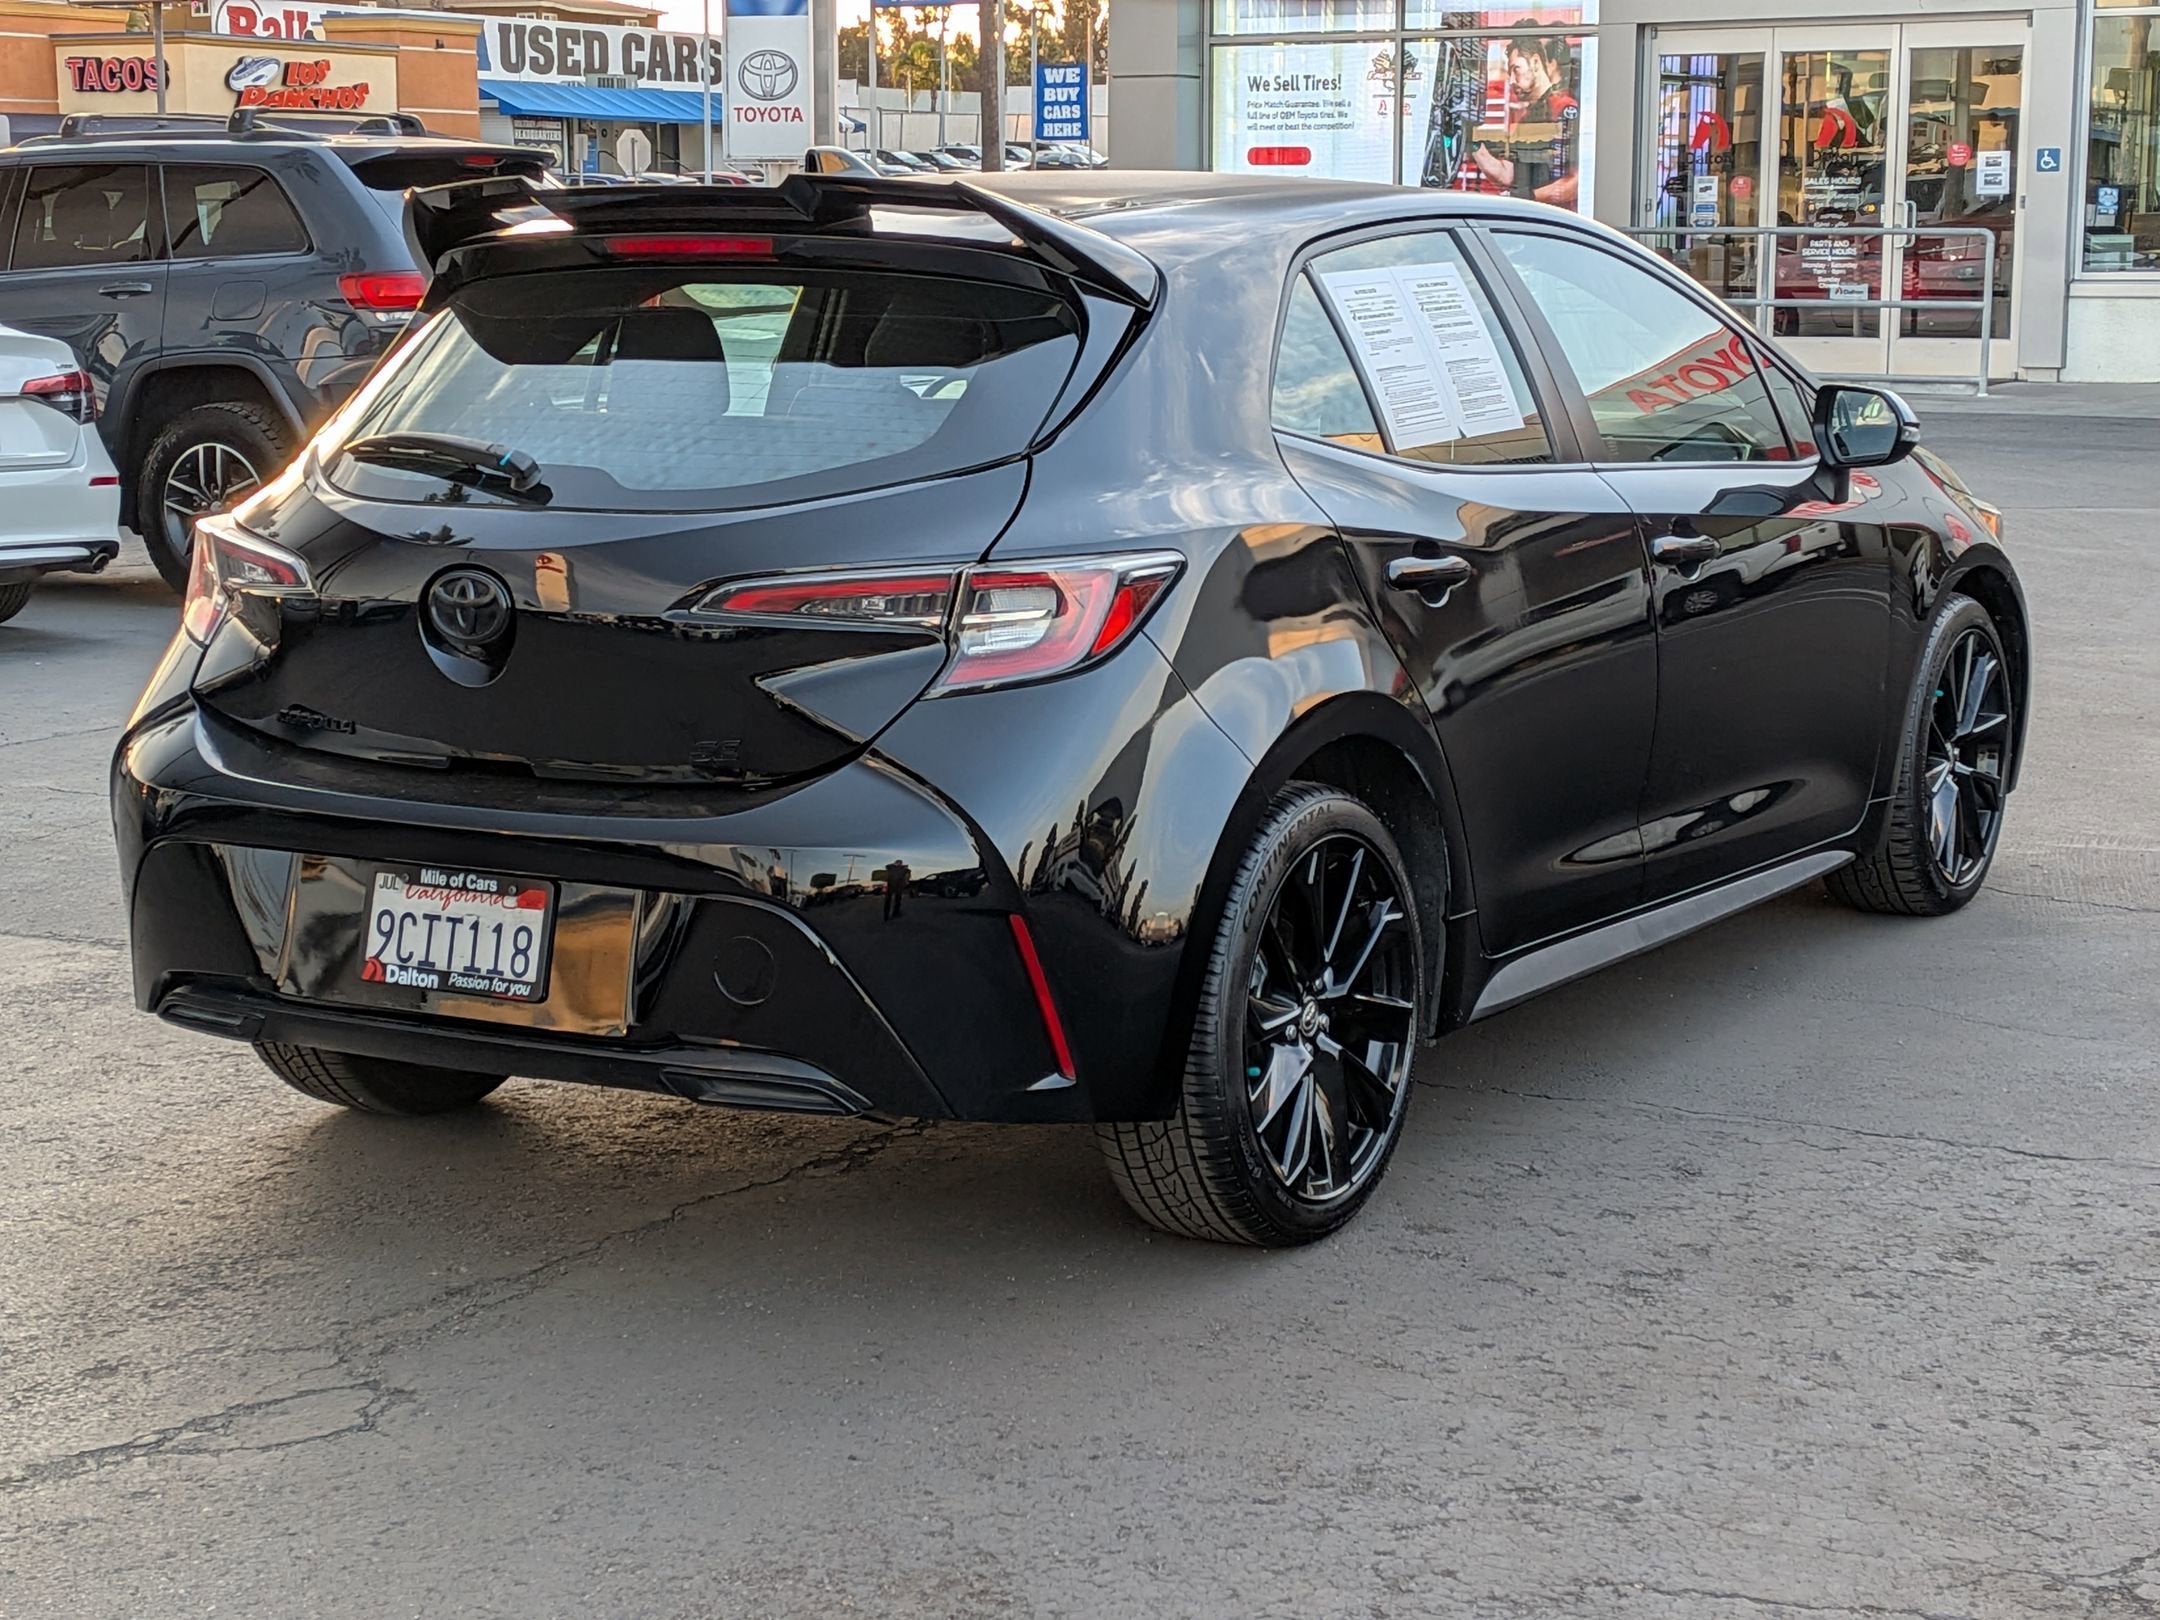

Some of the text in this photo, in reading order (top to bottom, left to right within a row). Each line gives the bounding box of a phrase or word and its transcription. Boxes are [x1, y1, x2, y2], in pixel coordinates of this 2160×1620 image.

[498, 22, 609, 77] USED
[621, 32, 722, 86] CARS
[64, 56, 170, 92] TACOS
[283, 58, 331, 87] LOS
[1044, 68, 1080, 84] WE
[1247, 73, 1342, 92] We Sell Tires!
[1044, 87, 1080, 102] BUY
[733, 107, 804, 123] TOYOTA
[1043, 105, 1081, 119] CARS
[1043, 122, 1082, 137] HERE
[1804, 176, 1862, 186] SALES HOURS
[1802, 246, 1857, 257] SERVICE HOURS
[1809, 239, 1850, 248] PARTS AND
[1243, 803, 1334, 933] CONTINENTAL
[378, 873, 401, 891] JUL
[420, 868, 498, 892] Mile of Cars
[374, 908, 533, 979] 9CIT118
[385, 964, 439, 989] Dalton
[448, 972, 532, 997] Passion for you
